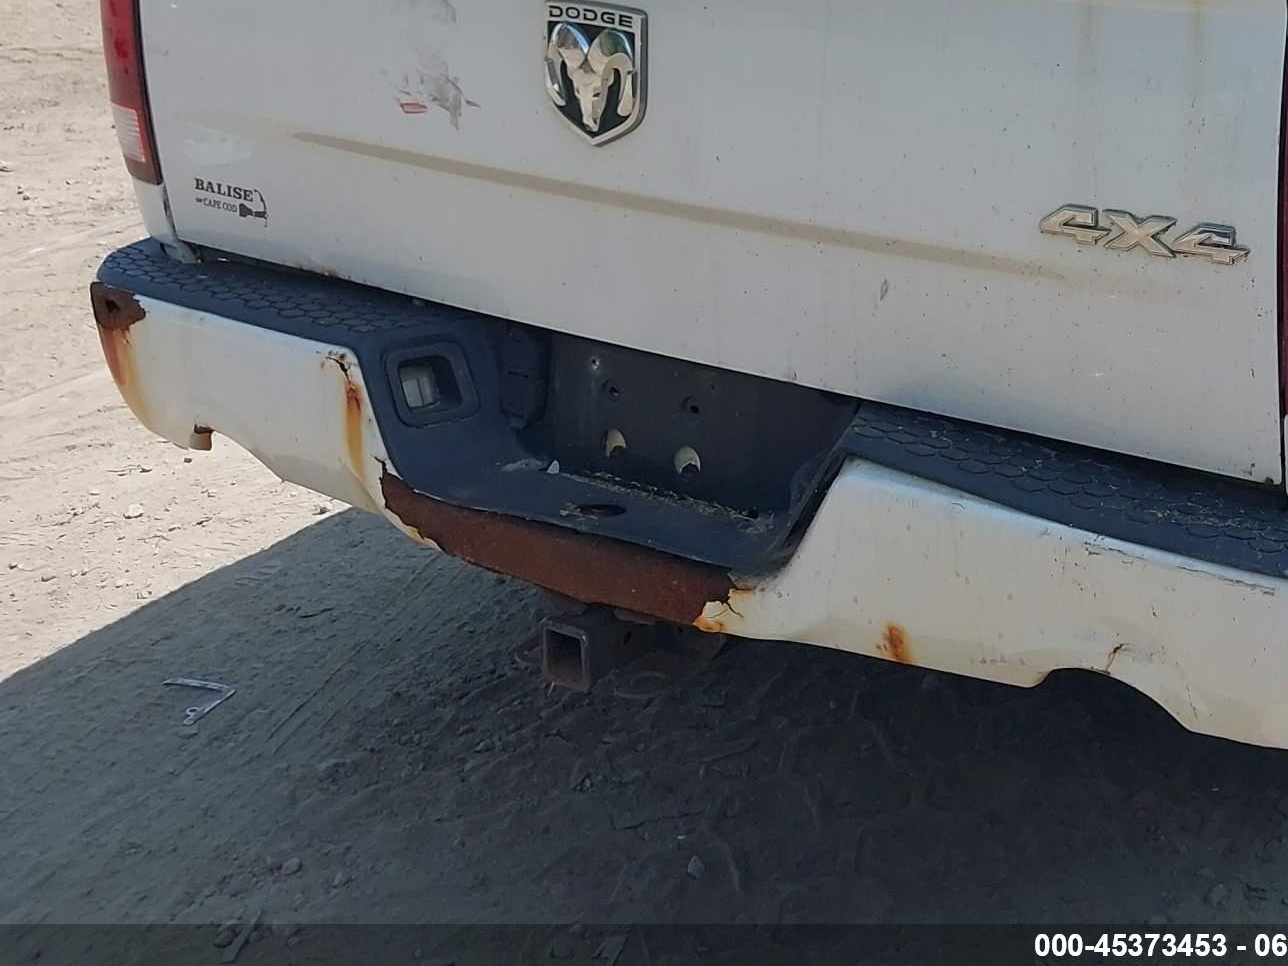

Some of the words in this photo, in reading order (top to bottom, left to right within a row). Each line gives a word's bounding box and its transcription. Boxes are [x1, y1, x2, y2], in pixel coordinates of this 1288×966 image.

[548, 4, 633, 28] DODGE
[194, 177, 254, 202] BALISE
[1039, 203, 1251, 265] 4X4
